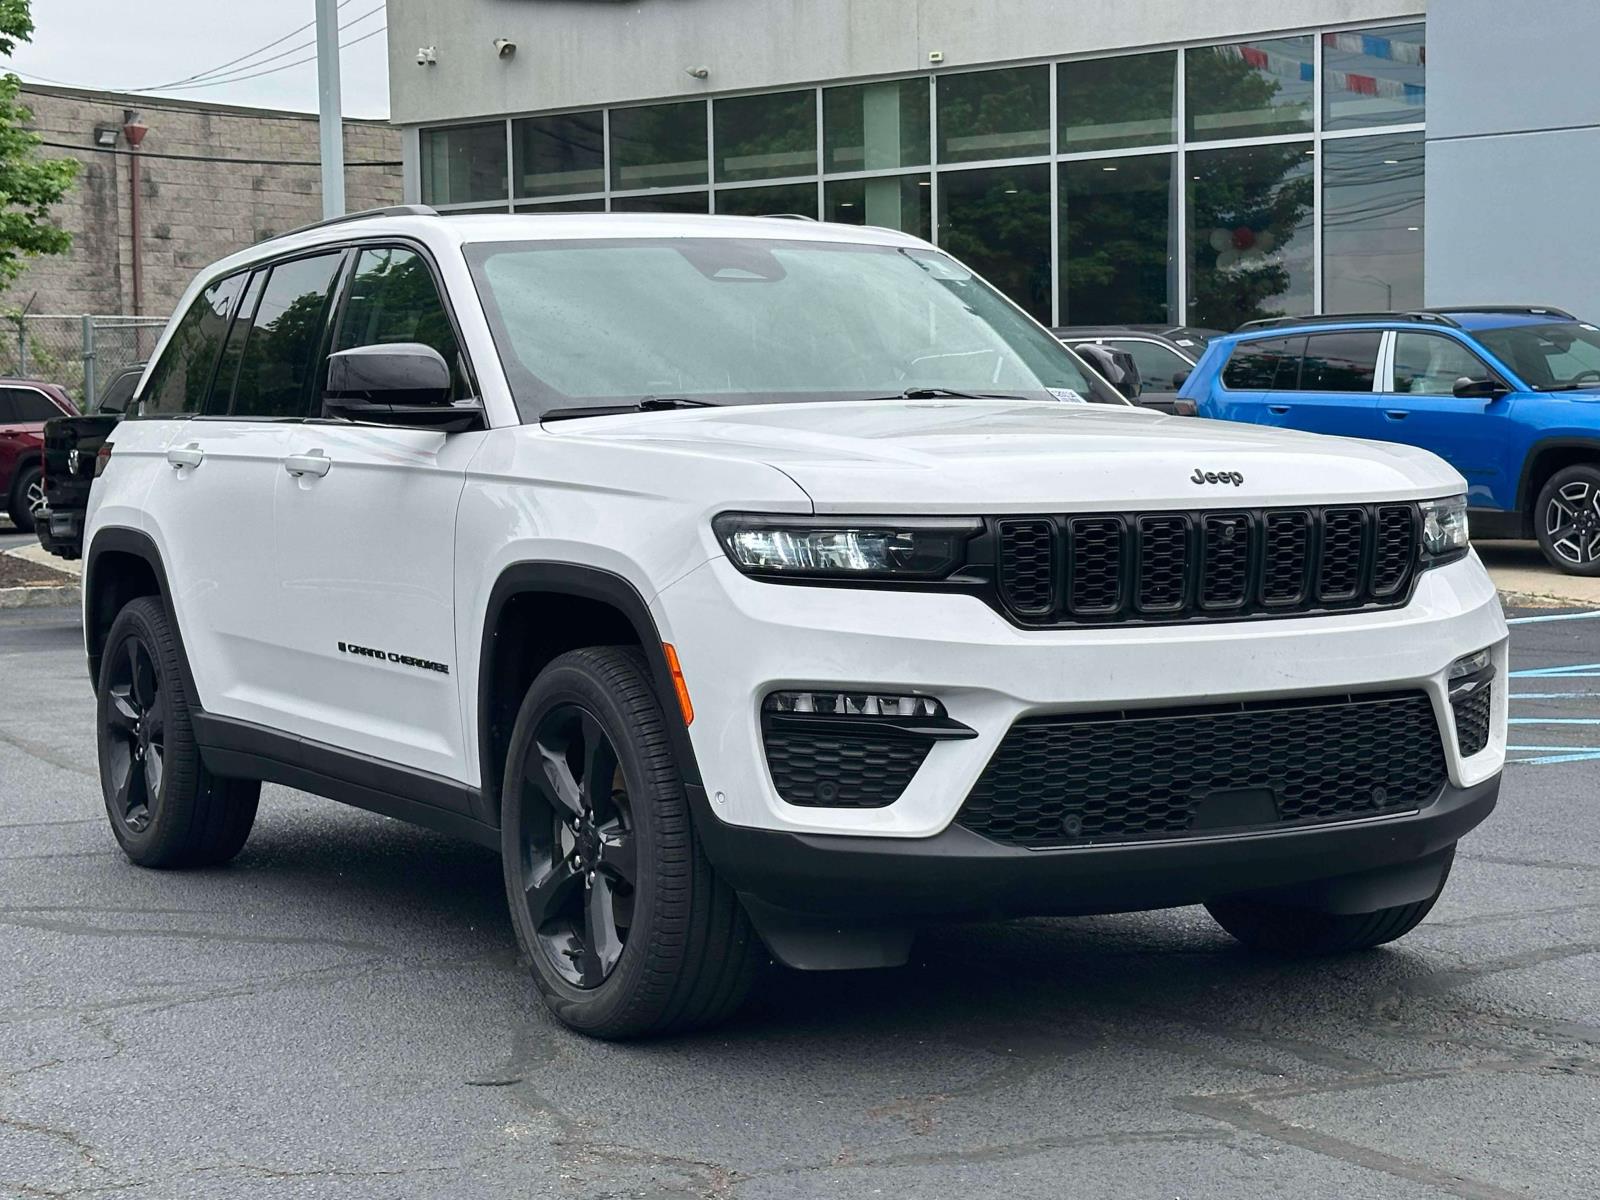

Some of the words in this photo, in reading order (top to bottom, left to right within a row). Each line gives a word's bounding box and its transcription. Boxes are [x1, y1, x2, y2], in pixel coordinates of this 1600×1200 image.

[1190, 468, 1243, 487] Jeep
[348, 644, 387, 660] GRAND
[388, 652, 450, 675] CHEROKEE
